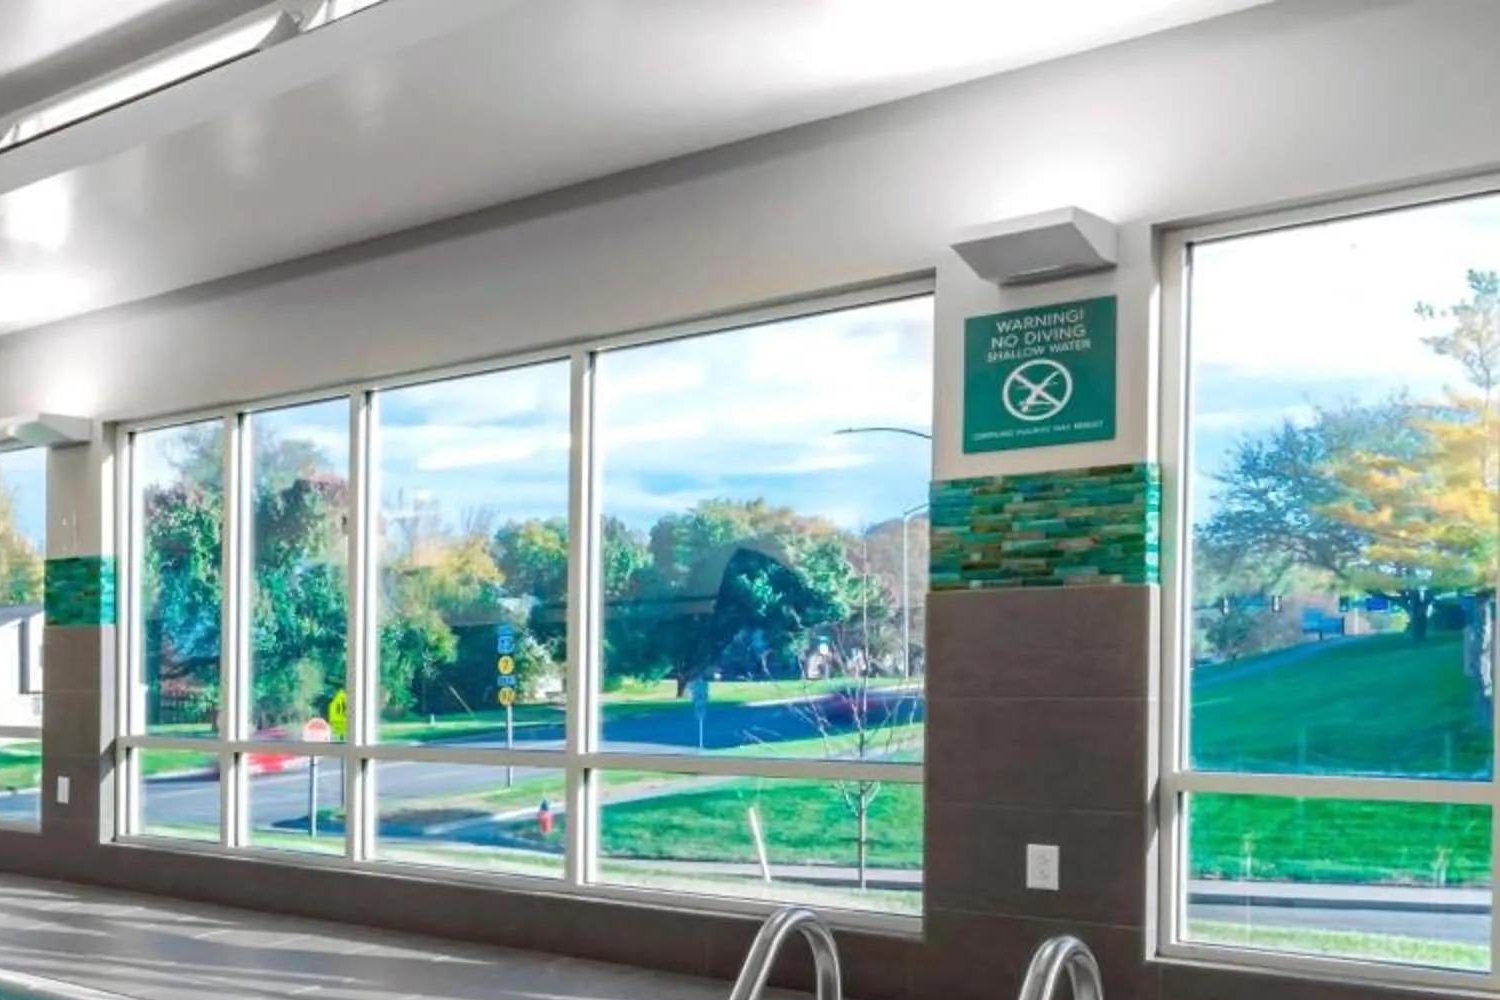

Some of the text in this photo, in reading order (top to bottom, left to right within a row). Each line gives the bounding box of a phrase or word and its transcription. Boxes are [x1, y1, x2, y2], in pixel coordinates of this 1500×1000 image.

[996, 308, 1084, 333] WARNING!
[991, 324, 1086, 349] NO DIVING
[987, 338, 1091, 363] SHALLOW WATER
